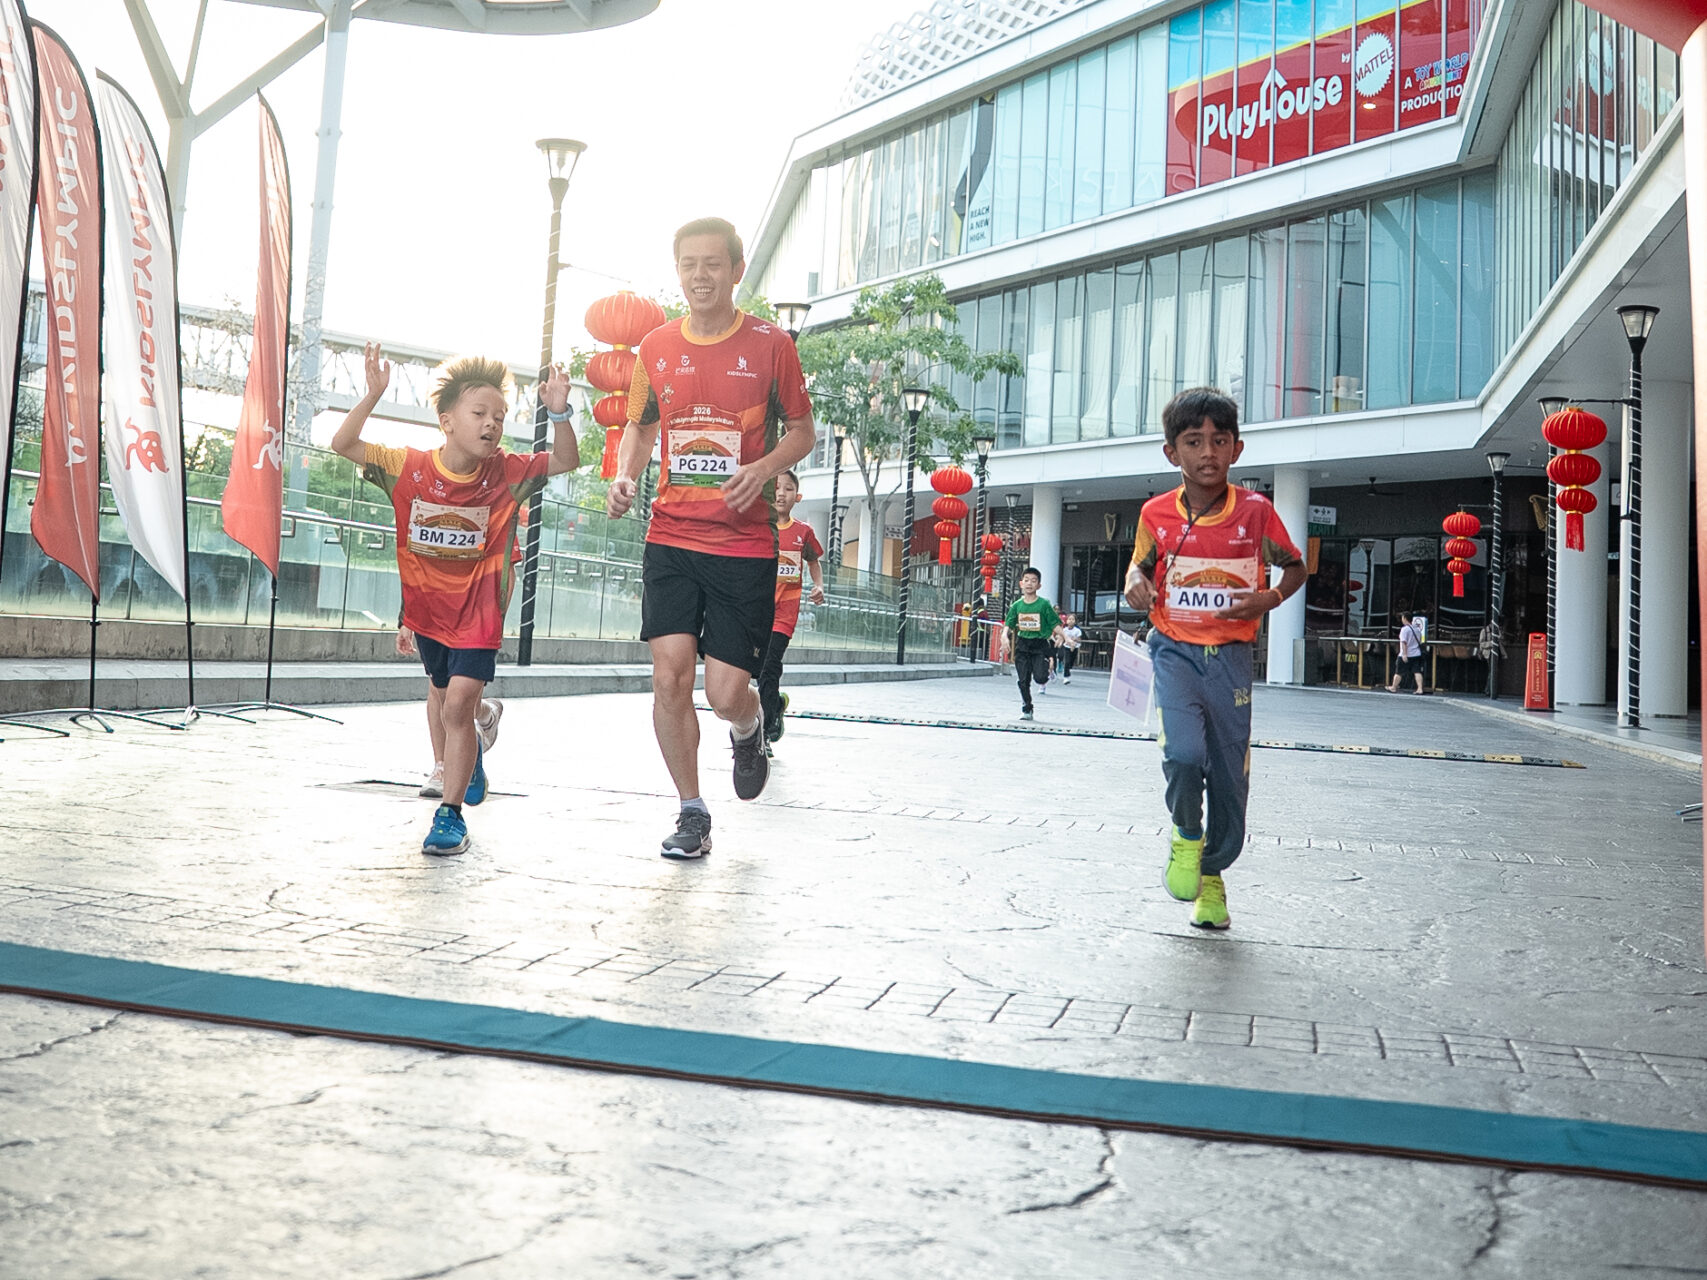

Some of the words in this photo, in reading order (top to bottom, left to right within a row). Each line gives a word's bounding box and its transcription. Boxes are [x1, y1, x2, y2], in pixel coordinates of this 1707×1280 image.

[1341, 52, 1351, 64] by
[1355, 48, 1394, 82] MATTEL
[1414, 64, 1432, 81] TOY
[1404, 76, 1413, 90] A
[970, 205, 990, 218] REACH
[975, 218, 989, 229] NEW
[679, 458, 697, 471] PG
[701, 460, 727, 472] 224
[419, 529, 444, 544] BM
[448, 534, 476, 546] 224
[780, 567, 795, 575] 237
[1178, 591, 1208, 608] AM
